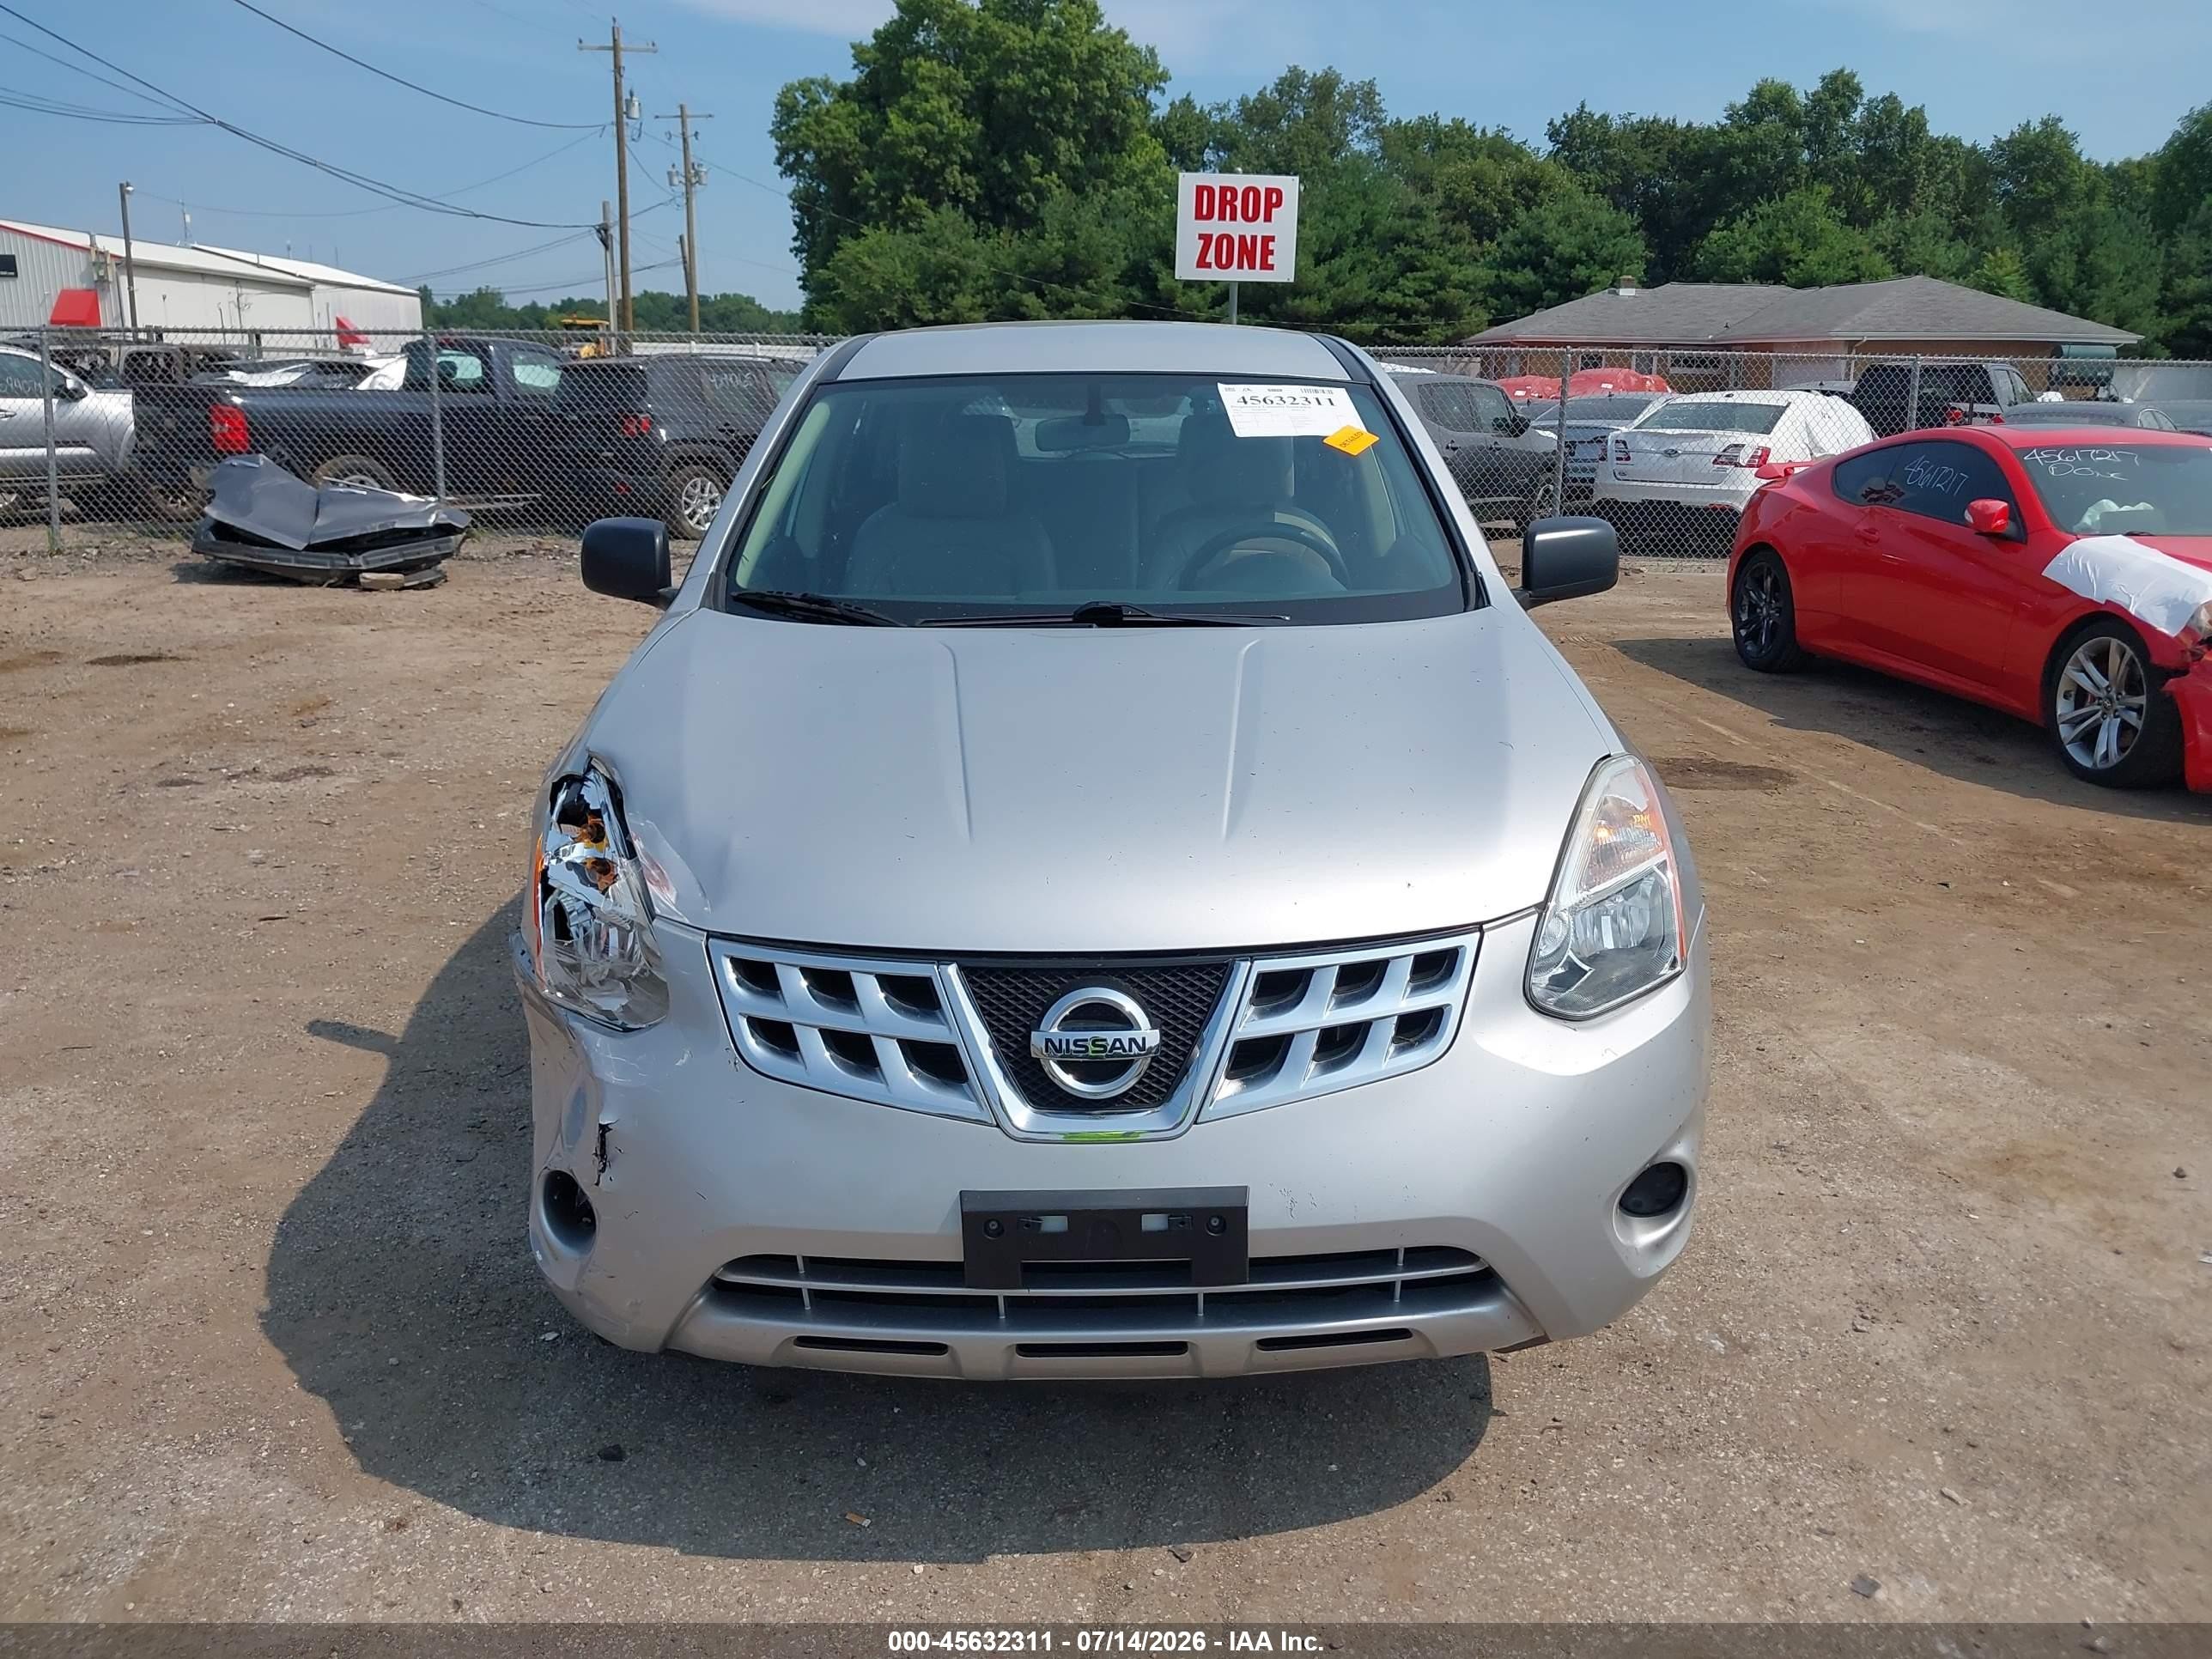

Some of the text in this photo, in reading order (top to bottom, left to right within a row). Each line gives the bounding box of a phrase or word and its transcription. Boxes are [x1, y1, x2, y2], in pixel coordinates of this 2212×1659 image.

[1194, 185, 1283, 223] DROP
[1195, 234, 1276, 270] ZONE
[1237, 395, 1336, 406] 45632311
[2023, 448, 2140, 466] 45617217
[1044, 1036, 1146, 1054] NISSAN
